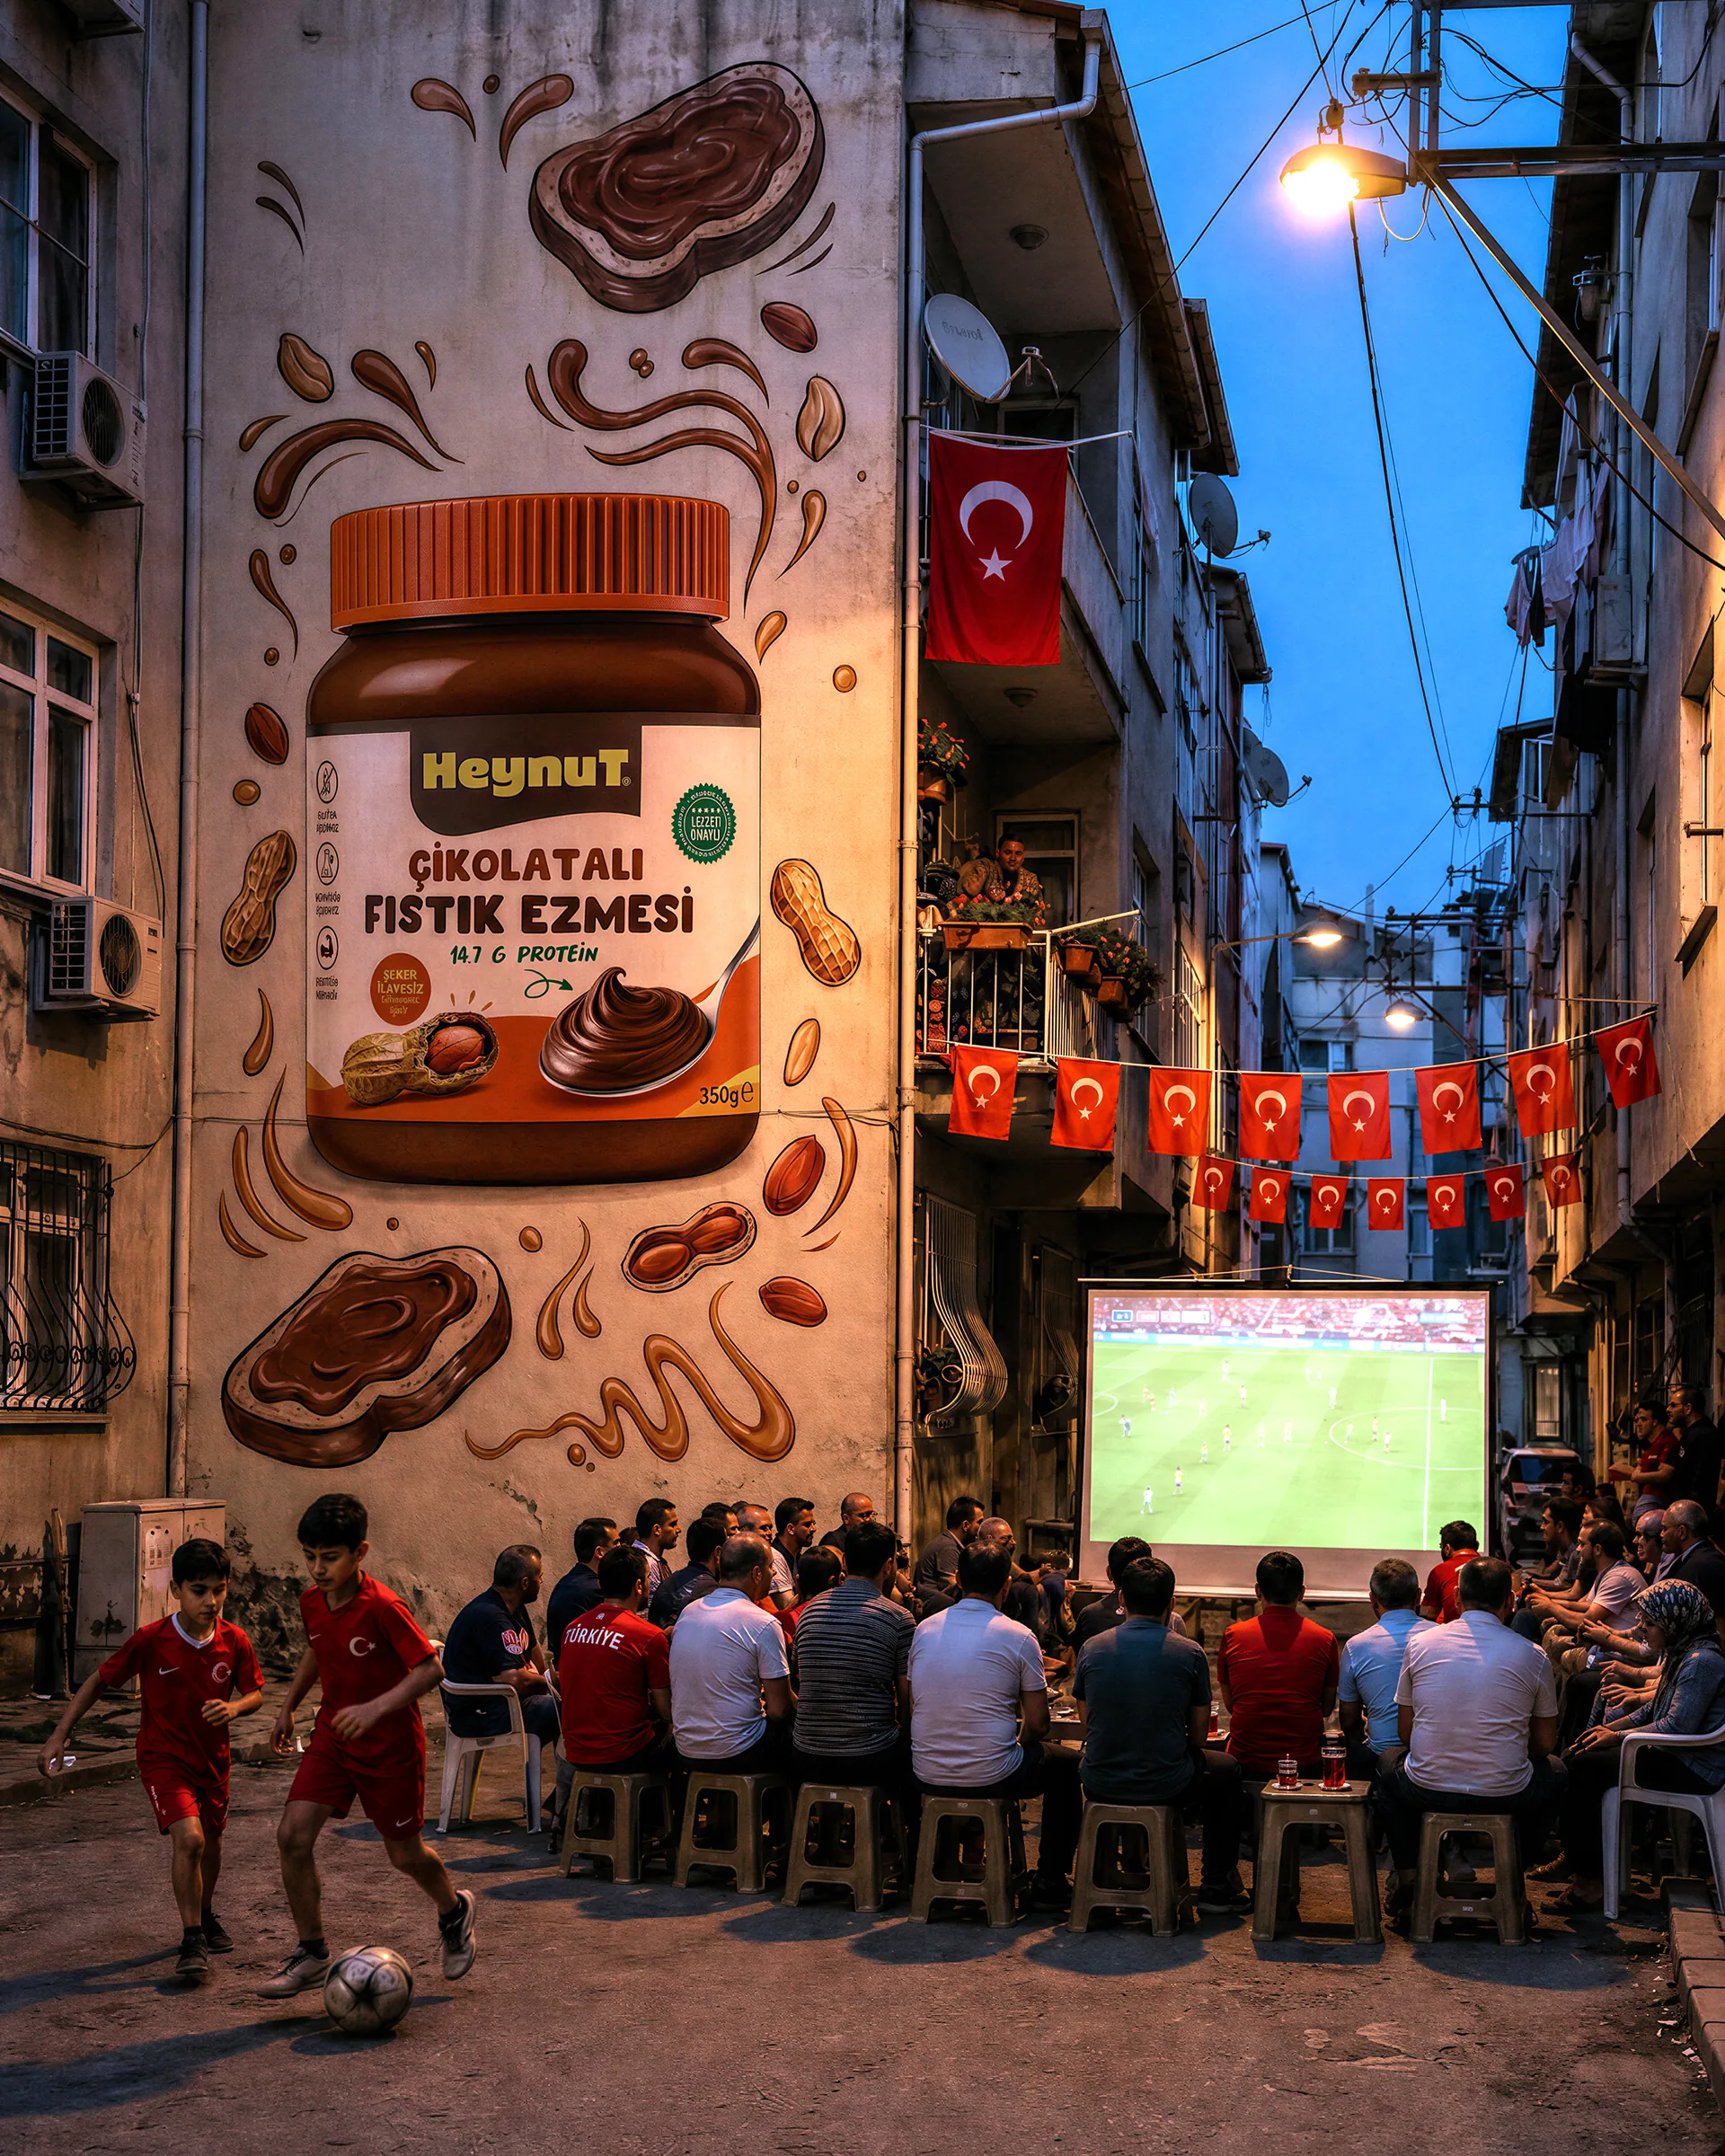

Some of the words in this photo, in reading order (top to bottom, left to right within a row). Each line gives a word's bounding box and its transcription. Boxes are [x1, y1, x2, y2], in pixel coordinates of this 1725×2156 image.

[409, 841, 643, 893] ÇİKOLATALI
[365, 894, 505, 934] FISTIK
[521, 886, 694, 934] EZMESİ
[450, 945, 482, 965] 14.7
[491, 945, 507, 964] G
[517, 941, 598, 964] PROTEİN
[377, 980, 424, 994] İLAVESİZ
[383, 969, 418, 984] ŞEKER
